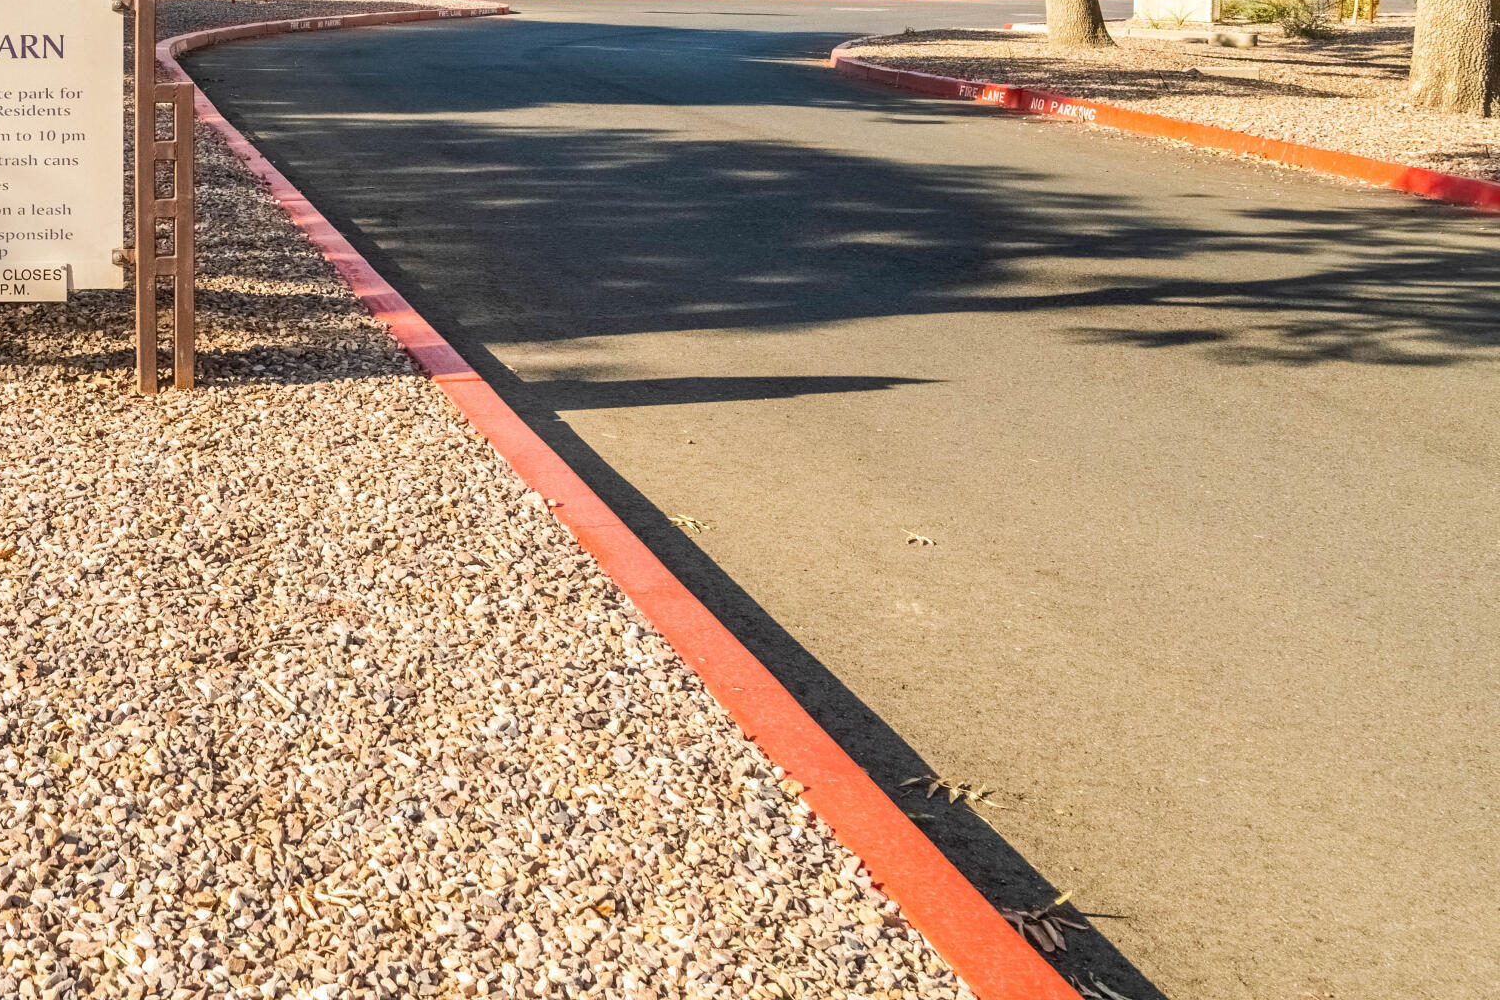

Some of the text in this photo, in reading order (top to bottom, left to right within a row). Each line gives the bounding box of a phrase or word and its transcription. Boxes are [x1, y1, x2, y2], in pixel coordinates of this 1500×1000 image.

[19, 88, 54, 102] park
[60, 88, 83, 99] for
[960, 85, 1005, 103] FIRE LANE
[1031, 98, 1044, 110] NO
[17, 132, 31, 141] to
[40, 130, 56, 141] 10
[62, 133, 85, 144] pm
[44, 158, 78, 166] cans
[32, 204, 71, 215] leash
[3, 269, 62, 281] CLOSES
[0, 283, 29, 295] P.M.
